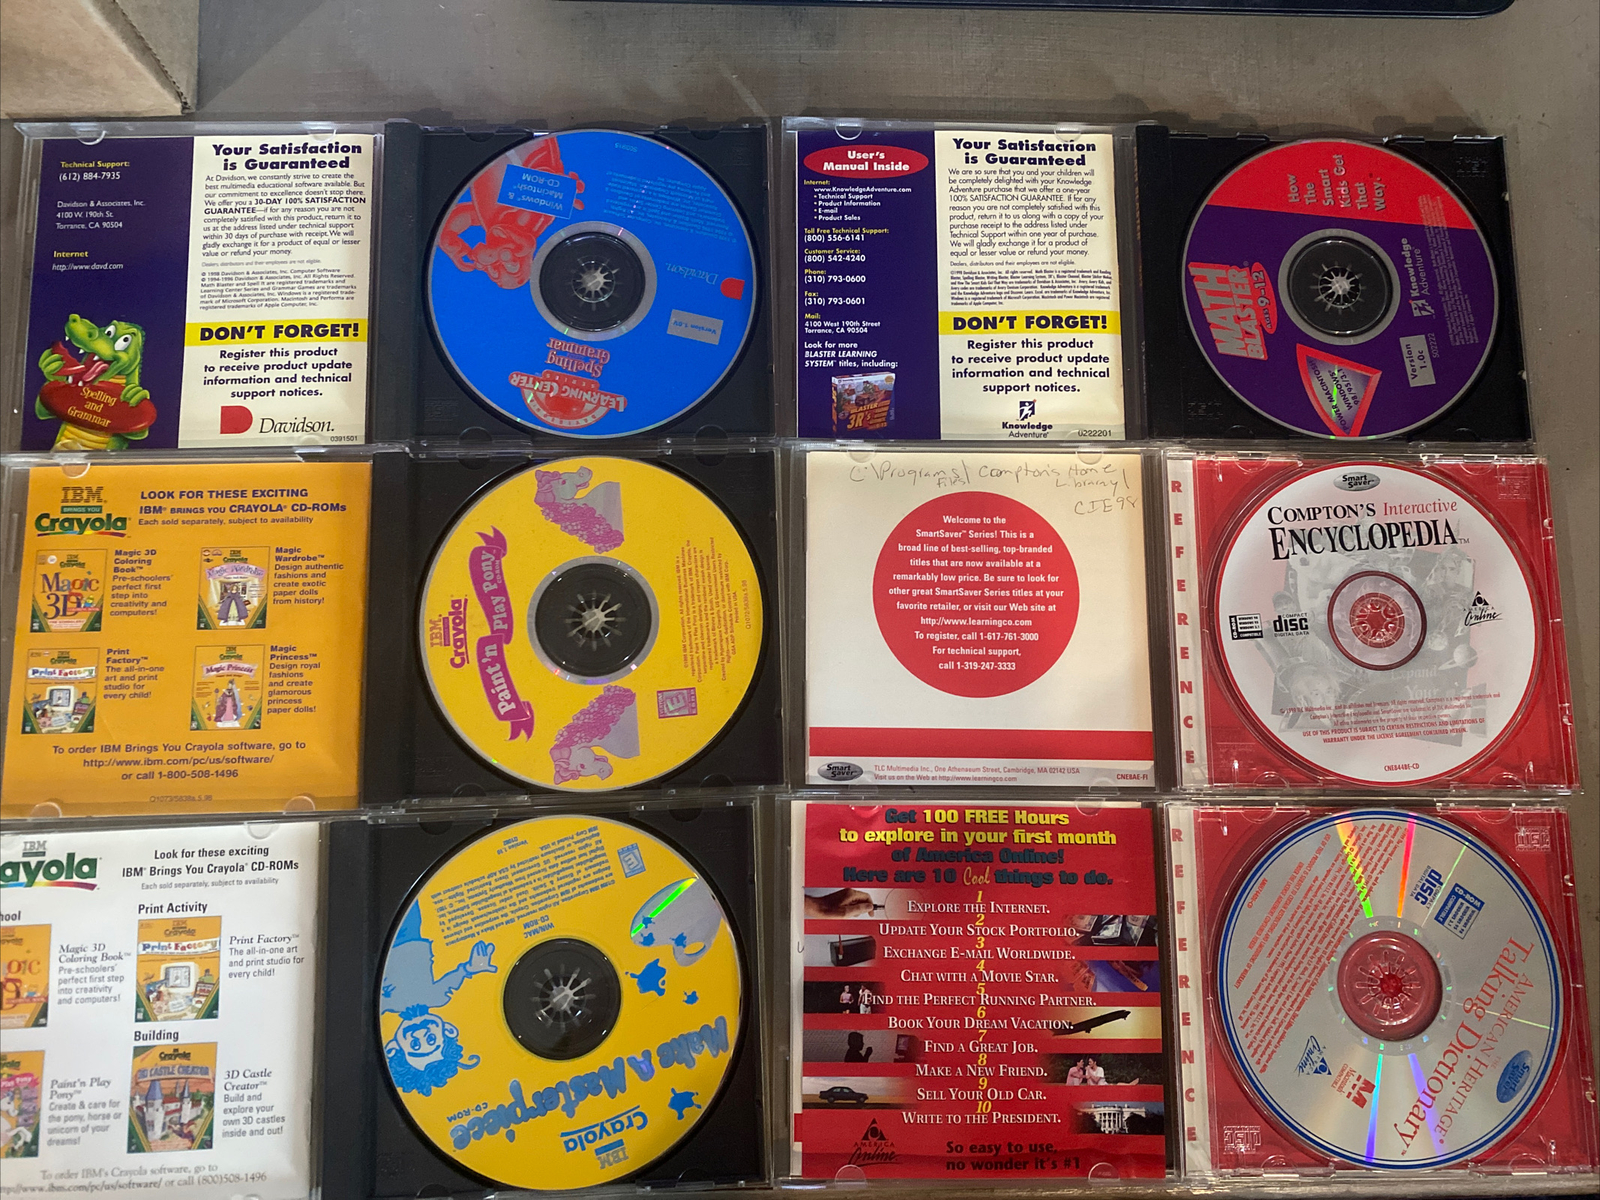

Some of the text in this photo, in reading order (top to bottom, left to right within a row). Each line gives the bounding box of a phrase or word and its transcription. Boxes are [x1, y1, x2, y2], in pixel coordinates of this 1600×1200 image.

[212, 142, 362, 157] Your Satisfaction
[953, 138, 1097, 153] Your Satisfaction
[847, 150, 885, 160] User's
[964, 153, 1086, 166] is Guaranteed
[61, 160, 130, 170] Technical Support:
[223, 156, 350, 171] is Guaranteed
[822, 161, 910, 171] Manual Inside
[59, 170, 121, 182] (612) 884-7935
[521, 172, 560, 188] CD-ROM
[1333, 154, 1351, 208] Kids Get
[813, 186, 912, 195] www.KnowledgeAdventure.com
[1287, 173, 1300, 203] How
[1304, 182, 1317, 205] The
[1318, 169, 1335, 206] Smart
[1373, 177, 1386, 211] Way.
[1355, 182, 1369, 210] That
[88, 221, 100, 230] CA
[102, 221, 123, 230] 90504
[804, 234, 865, 243] (800) 556-6141
[950, 230, 979, 238] Technical
[980, 230, 1006, 240] Support
[1008, 230, 1028, 238] within
[1043, 232, 1058, 240] year
[1059, 230, 1067, 238] of
[1067, 231, 1098, 240] purchase.
[230, 249, 251, 257] refund
[253, 250, 268, 259] your
[1401, 237, 1420, 297] Knowledge
[1251, 270, 1270, 307] 9-12
[804, 297, 866, 306] (310) 793-0601
[1189, 266, 1248, 357] MATH
[1227, 268, 1265, 359] BLASTER
[952, 315, 1108, 331] DON'T FORGET!
[200, 323, 360, 342] DON'T FORGET!
[219, 347, 338, 360] Register this product
[546, 338, 611, 364] Grammar
[545, 350, 602, 378] Spelling
[1405, 343, 1419, 380] Version
[510, 373, 558, 398] CENTER
[80, 387, 117, 407] Spelling
[230, 387, 323, 401] support notices.
[560, 385, 625, 412] LEARNING
[84, 401, 104, 413] and
[67, 406, 111, 428] Grammar
[259, 417, 335, 434] Davidson.
[1002, 421, 1053, 431] Knowledge
[1077, 429, 1112, 438] 0222201
[330, 435, 358, 443] 0391501
[1341, 473, 1368, 483] Smart
[1347, 479, 1371, 489] Saver
[61, 486, 104, 503] IBM
[140, 488, 309, 500] LOOK FOR THESE EXCITING
[1267, 498, 1458, 525] COMPTON'S Interactive
[35, 513, 128, 535] Crayola
[942, 515, 1007, 525] Welcome to the
[1269, 517, 1459, 561] ENCYCLOPEDIA
[114, 549, 142, 558] Magic
[481, 551, 498, 594] Pony
[490, 595, 508, 631] Play
[920, 617, 1032, 628] http://www.learningco.com
[1273, 614, 1309, 633] disc
[448, 598, 466, 669] Crayola
[914, 631, 1039, 642] To register, call 1-617-761-3000
[267, 705, 317, 715] paper dolls!
[121, 769, 239, 780] or call 1-800-508-1496
[885, 808, 1070, 826] Get 100 FREE Hours
[22, 840, 48, 851] IBM
[154, 844, 270, 860] Look for these exciting
[138, 901, 208, 915] Print Activity
[907, 900, 1050, 914] EXPLORE THE INTERNET.
[523, 914, 550, 930] CD-ROM
[523, 922, 555, 939] WIN/MAC
[1479, 972, 1535, 1058] AMERICAN
[133, 1029, 179, 1043] Building
[1393, 936, 1535, 1149] Talking Dictionary
[224, 1067, 273, 1080] 3D Castle
[449, 1015, 729, 1151] Make A Masterpiece
[917, 1087, 1047, 1101] SELL YOUR OLD CAR.
[446, 1101, 489, 1123] CD-ROM
[976, 1100, 992, 1114] 10
[563, 1111, 649, 1153] Crayola
[599, 1146, 629, 1170] IBM
[946, 1156, 1080, 1171] no wonder it's #1
